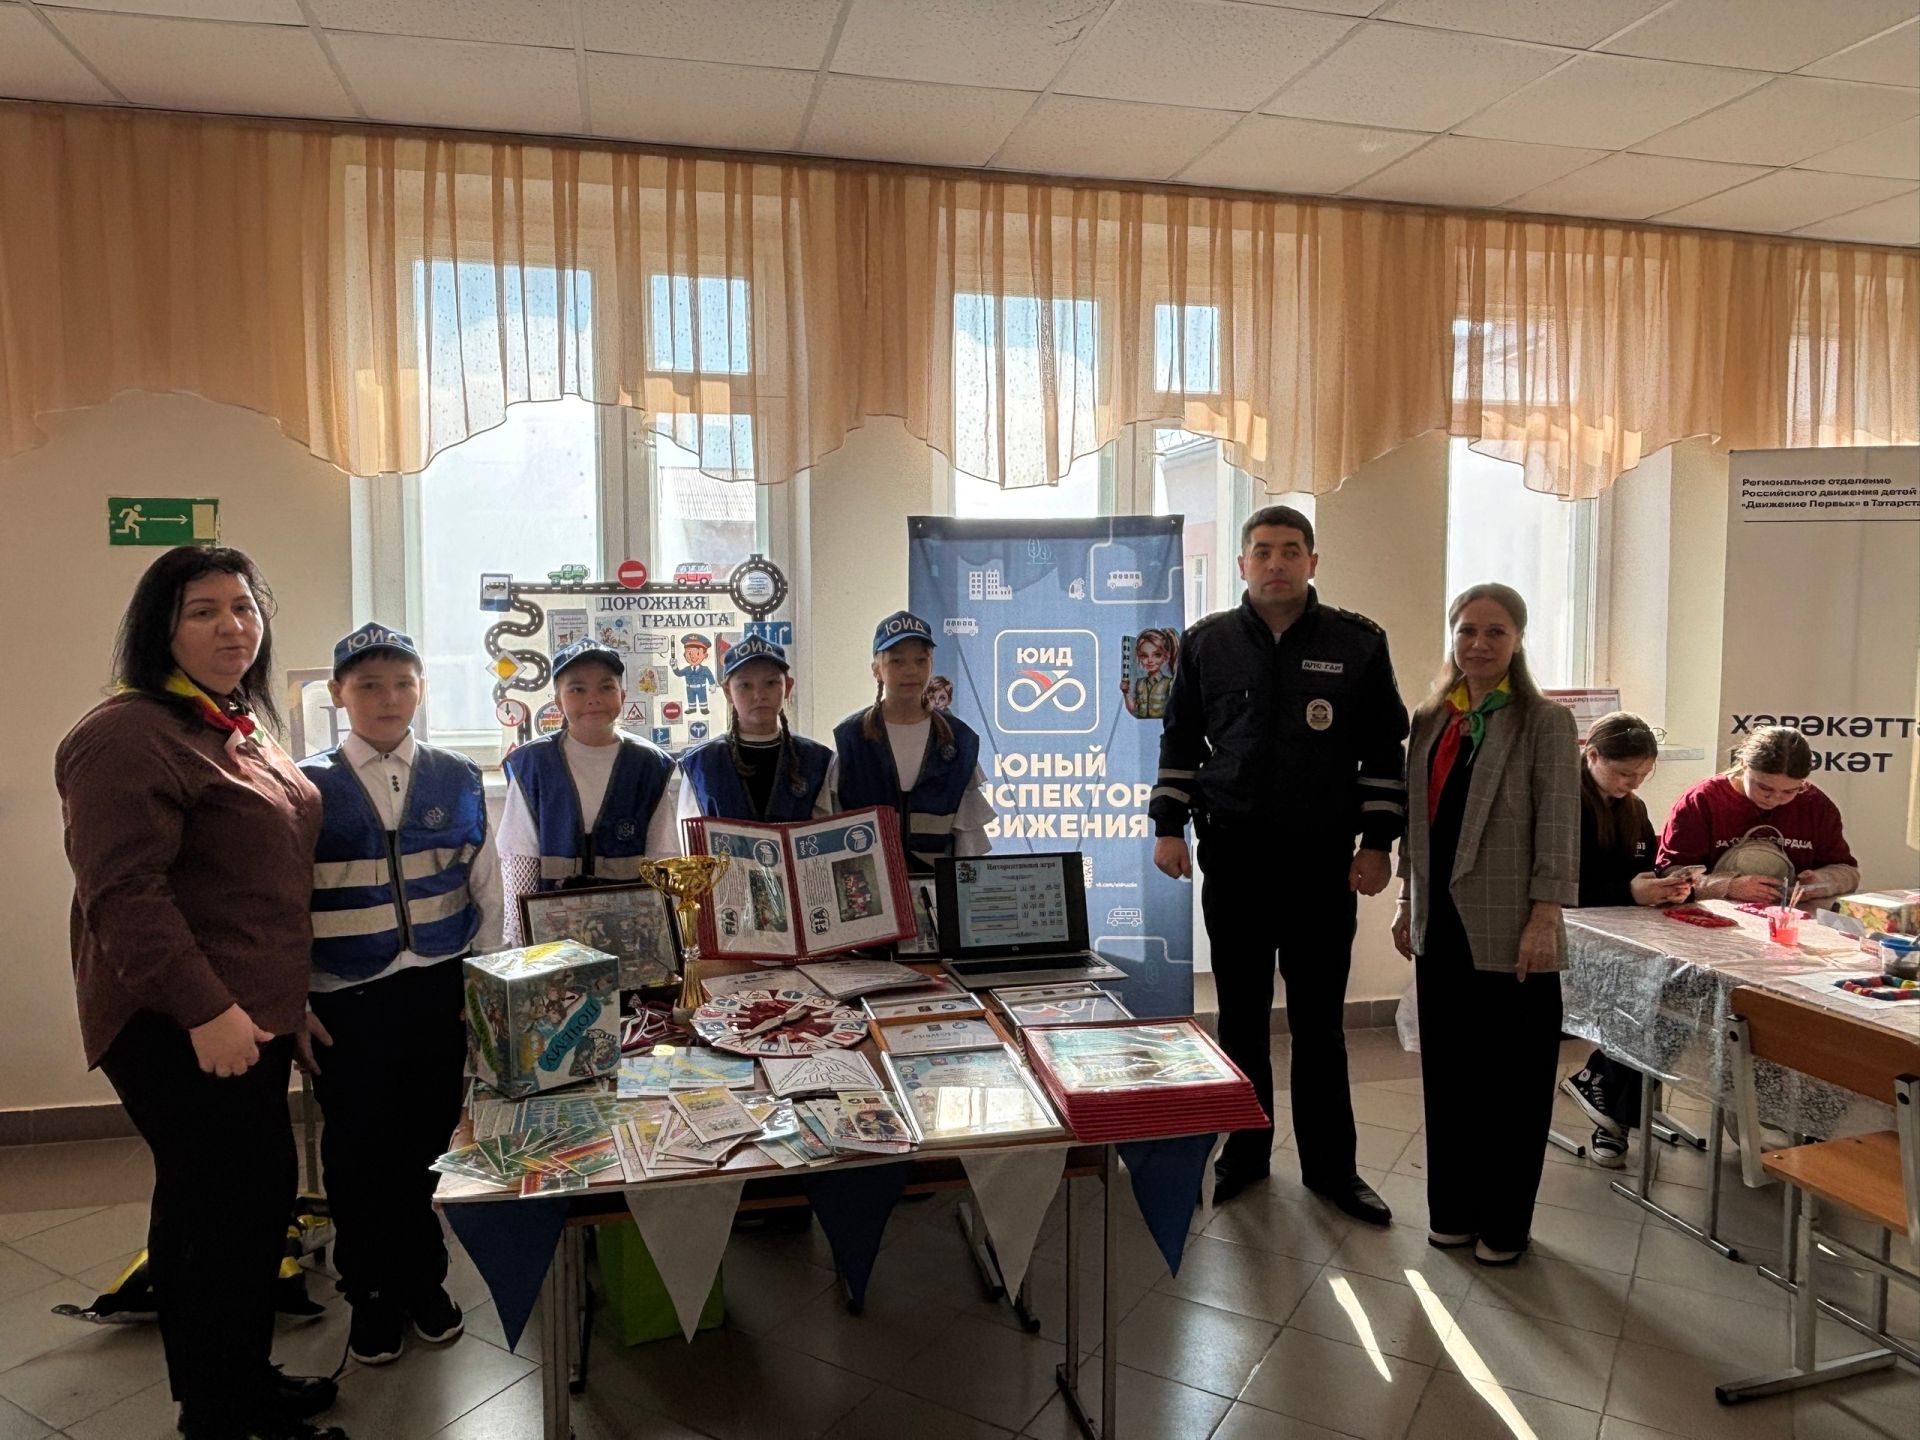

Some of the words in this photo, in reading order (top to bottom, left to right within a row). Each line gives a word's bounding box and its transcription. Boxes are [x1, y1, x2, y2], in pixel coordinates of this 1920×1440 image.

[1742, 478, 1826, 487] Региональное
[1828, 477, 1892, 485] отделение
[1741, 487, 1817, 498] Российского
[1819, 488, 1879, 497] движения
[1880, 487, 1917, 497] детей
[601, 595, 707, 612] ДОРОЖНАЯ
[641, 613, 731, 628] ГРАМОТА
[885, 617, 926, 636] ЮИД
[347, 629, 403, 652] ЮИД
[734, 640, 775, 660] ЮИД
[1016, 647, 1073, 667] ЮИД
[1731, 714, 1920, 738] ХӘРӘКӘТТ
[994, 744, 1107, 778] ЮНЫЙ
[983, 814, 1149, 838] ВИЖЕНИЯ
[724, 911, 737, 935] FIA
[813, 909, 829, 934] FIA
